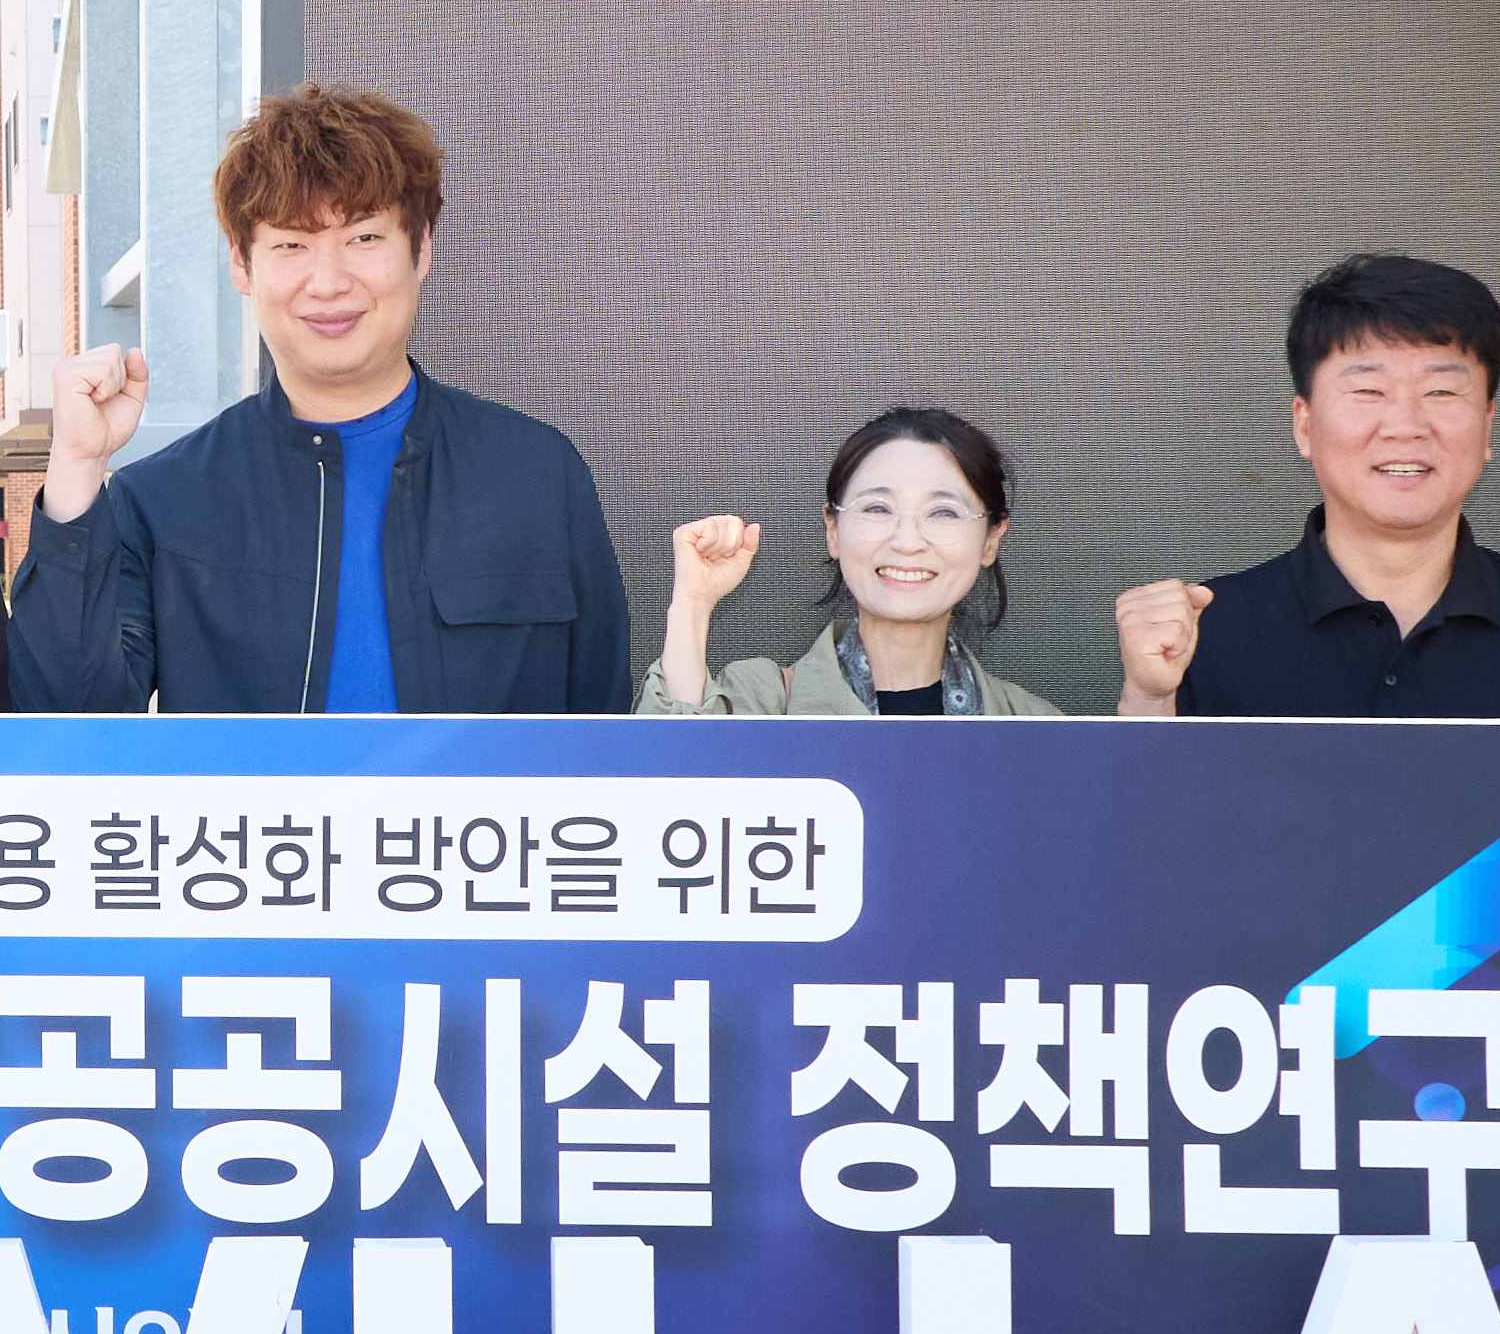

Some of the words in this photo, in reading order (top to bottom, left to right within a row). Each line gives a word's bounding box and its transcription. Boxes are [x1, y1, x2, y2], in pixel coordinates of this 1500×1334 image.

[90, 812, 341, 912] 활성화
[376, 815, 622, 913] 방안을
[658, 815, 826, 915] 위한
